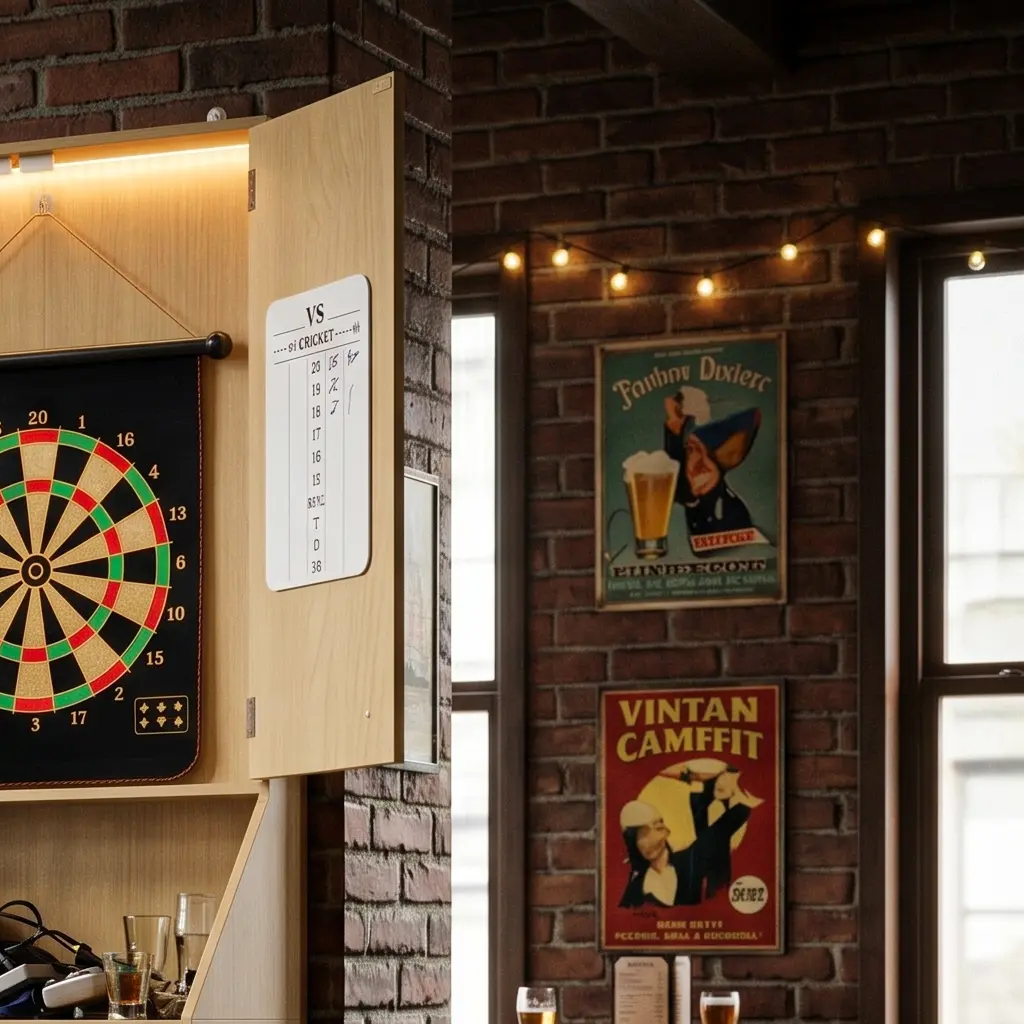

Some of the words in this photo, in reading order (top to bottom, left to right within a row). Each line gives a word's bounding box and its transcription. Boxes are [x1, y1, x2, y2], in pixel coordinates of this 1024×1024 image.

[306, 303, 325, 327] VS
[298, 328, 334, 350] CRICKET
[312, 382, 321, 396] 19
[28, 411, 48, 425] 20
[312, 405, 321, 419] 18
[78, 416, 86, 429] 1
[117, 433, 134, 447] 16
[312, 450, 321, 463] 16
[148, 465, 160, 479] 4
[169, 506, 187, 521] 13
[312, 516, 320, 529] T
[176, 555, 186, 570] 6
[311, 560, 322, 573] 36
[167, 606, 185, 621] 10
[146, 651, 164, 665] 15
[114, 687, 124, 700] 2
[70, 711, 87, 725] 17
[619, 697, 759, 727] VINTAN
[31, 718, 41, 732] 3
[616, 728, 764, 763] CAMFFIT
